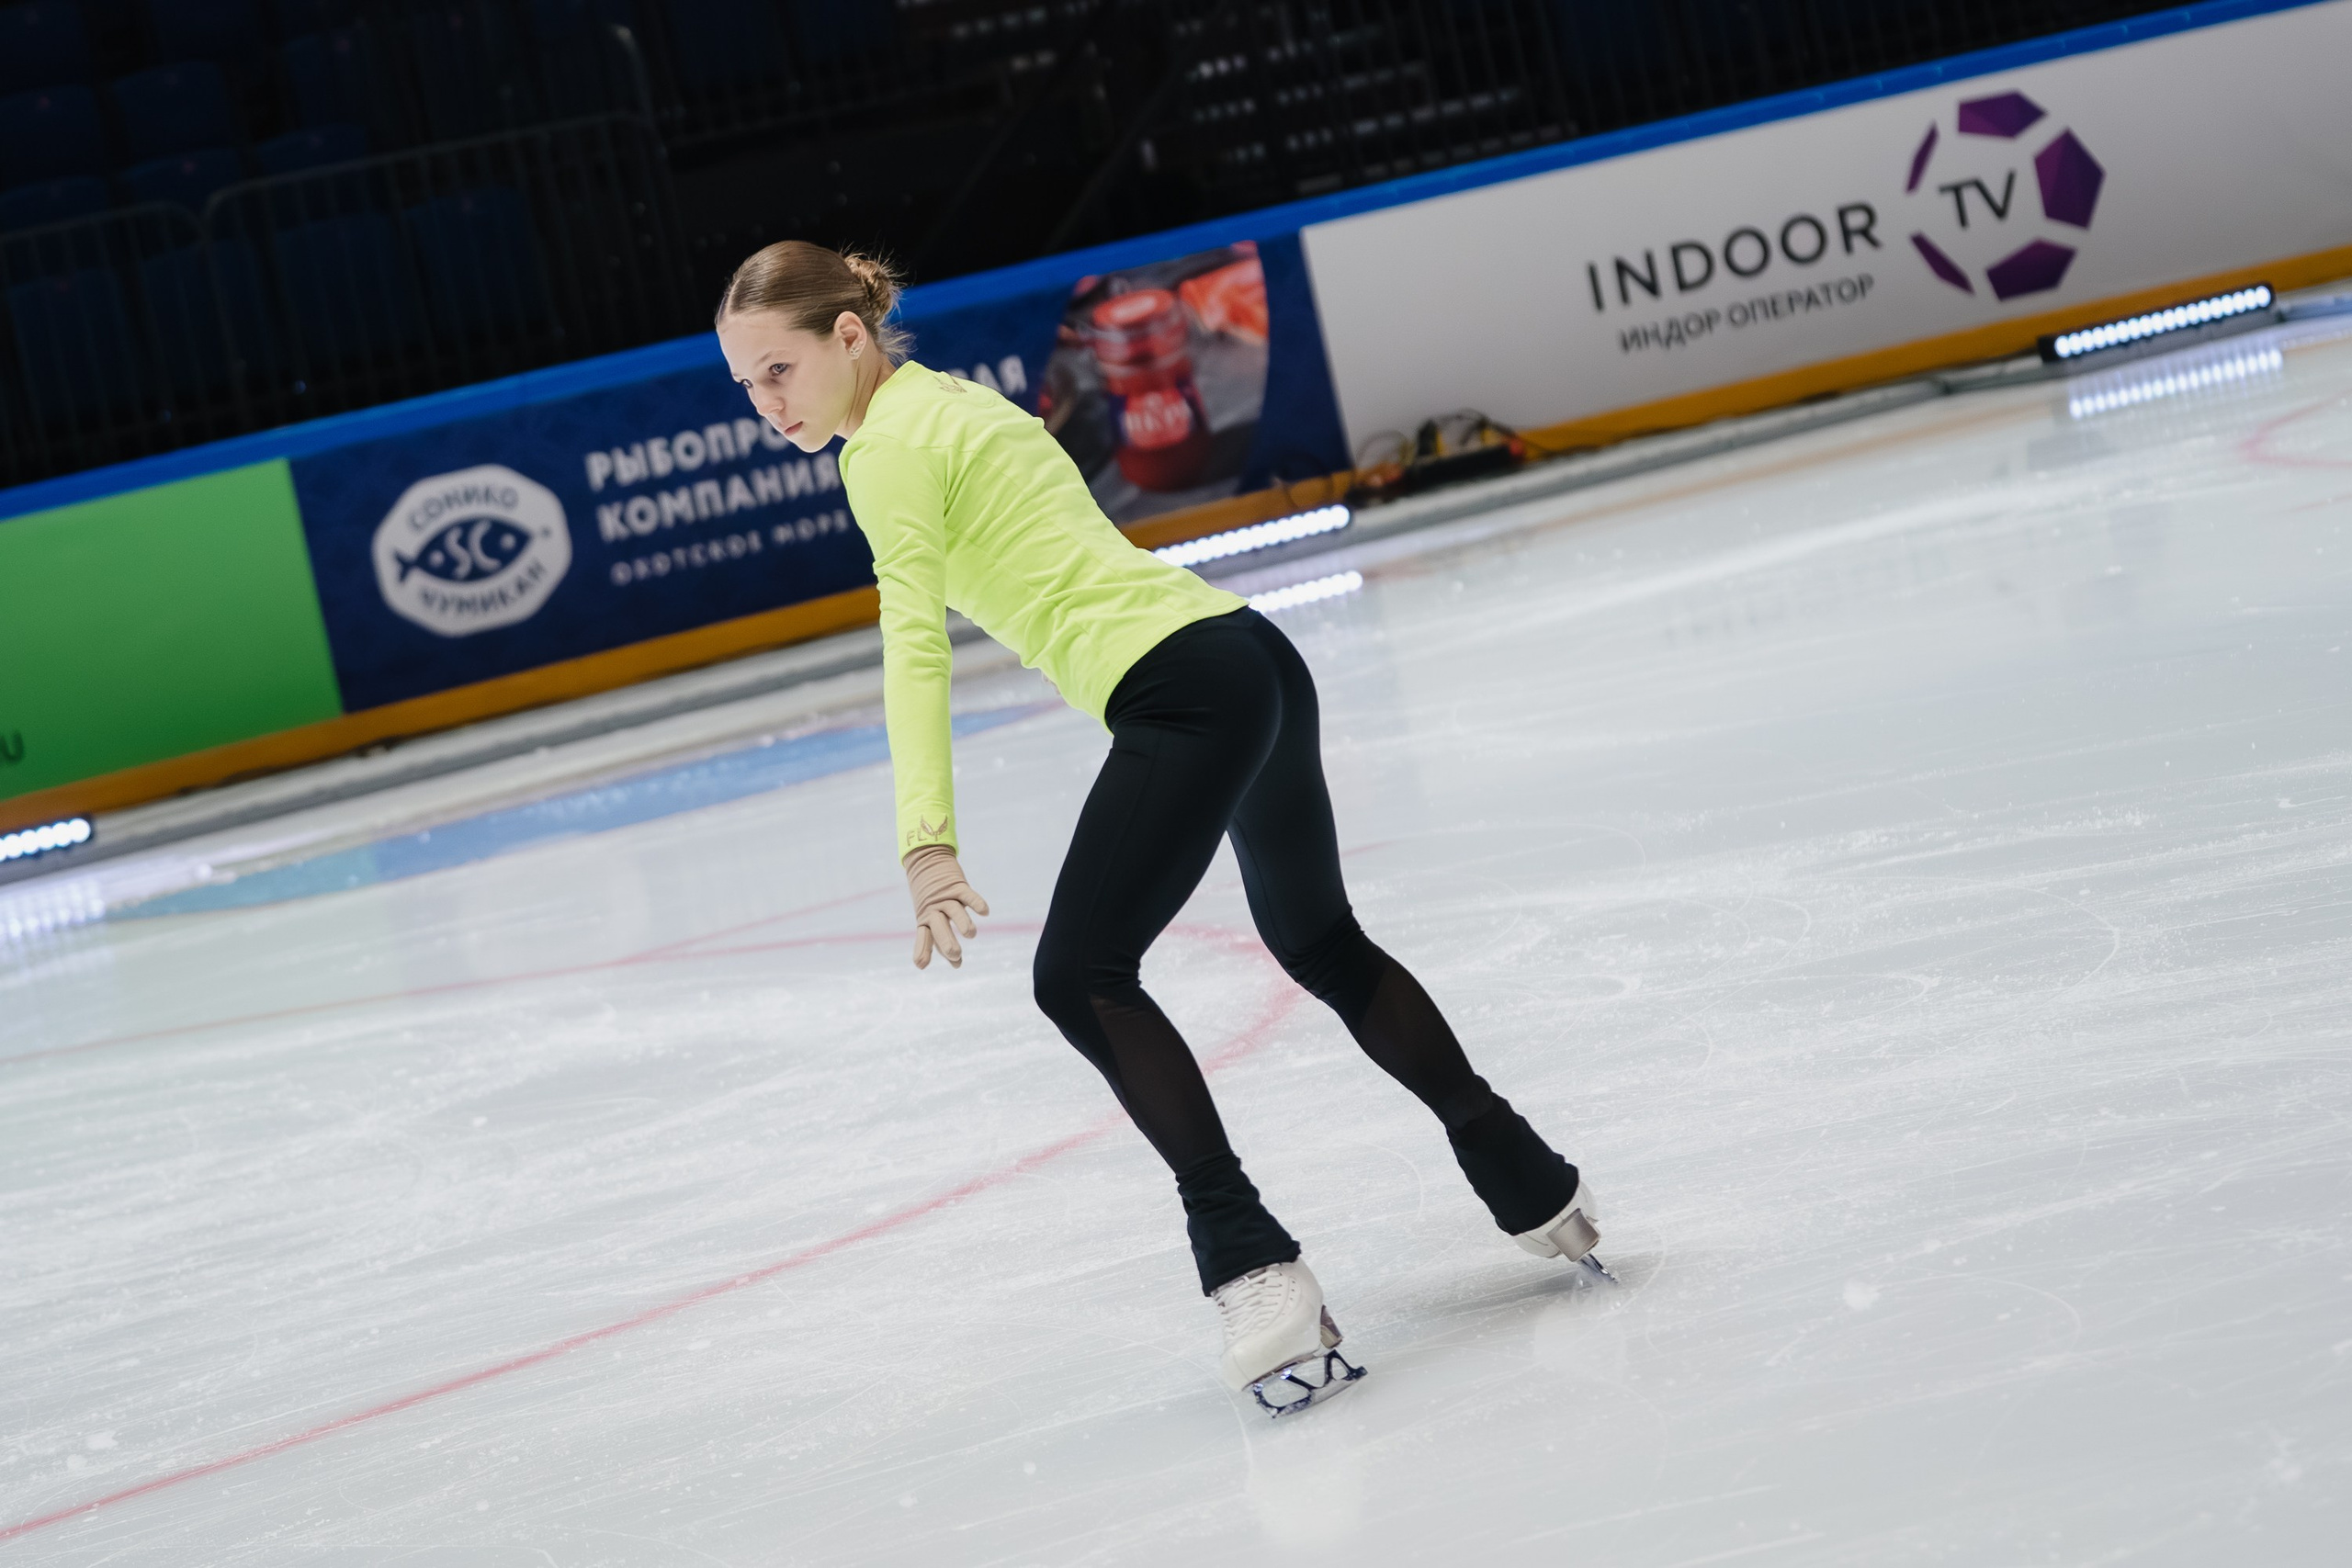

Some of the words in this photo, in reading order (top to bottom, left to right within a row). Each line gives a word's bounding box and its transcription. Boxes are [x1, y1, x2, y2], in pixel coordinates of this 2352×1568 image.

[1939, 169, 2017, 230] TV
[1587, 201, 1883, 312] INDOOR
[1620, 308, 1722, 354] ИНДОР
[1726, 273, 1874, 329] ОПЕРАТОР
[407, 485, 519, 533] СОНИКО
[596, 452, 841, 543] КОМПАНИЯ
[610, 530, 763, 586] ОХОТСКОЕ
[772, 508, 848, 545] МОРЕ
[418, 558, 548, 615] ЧУМИКАН
